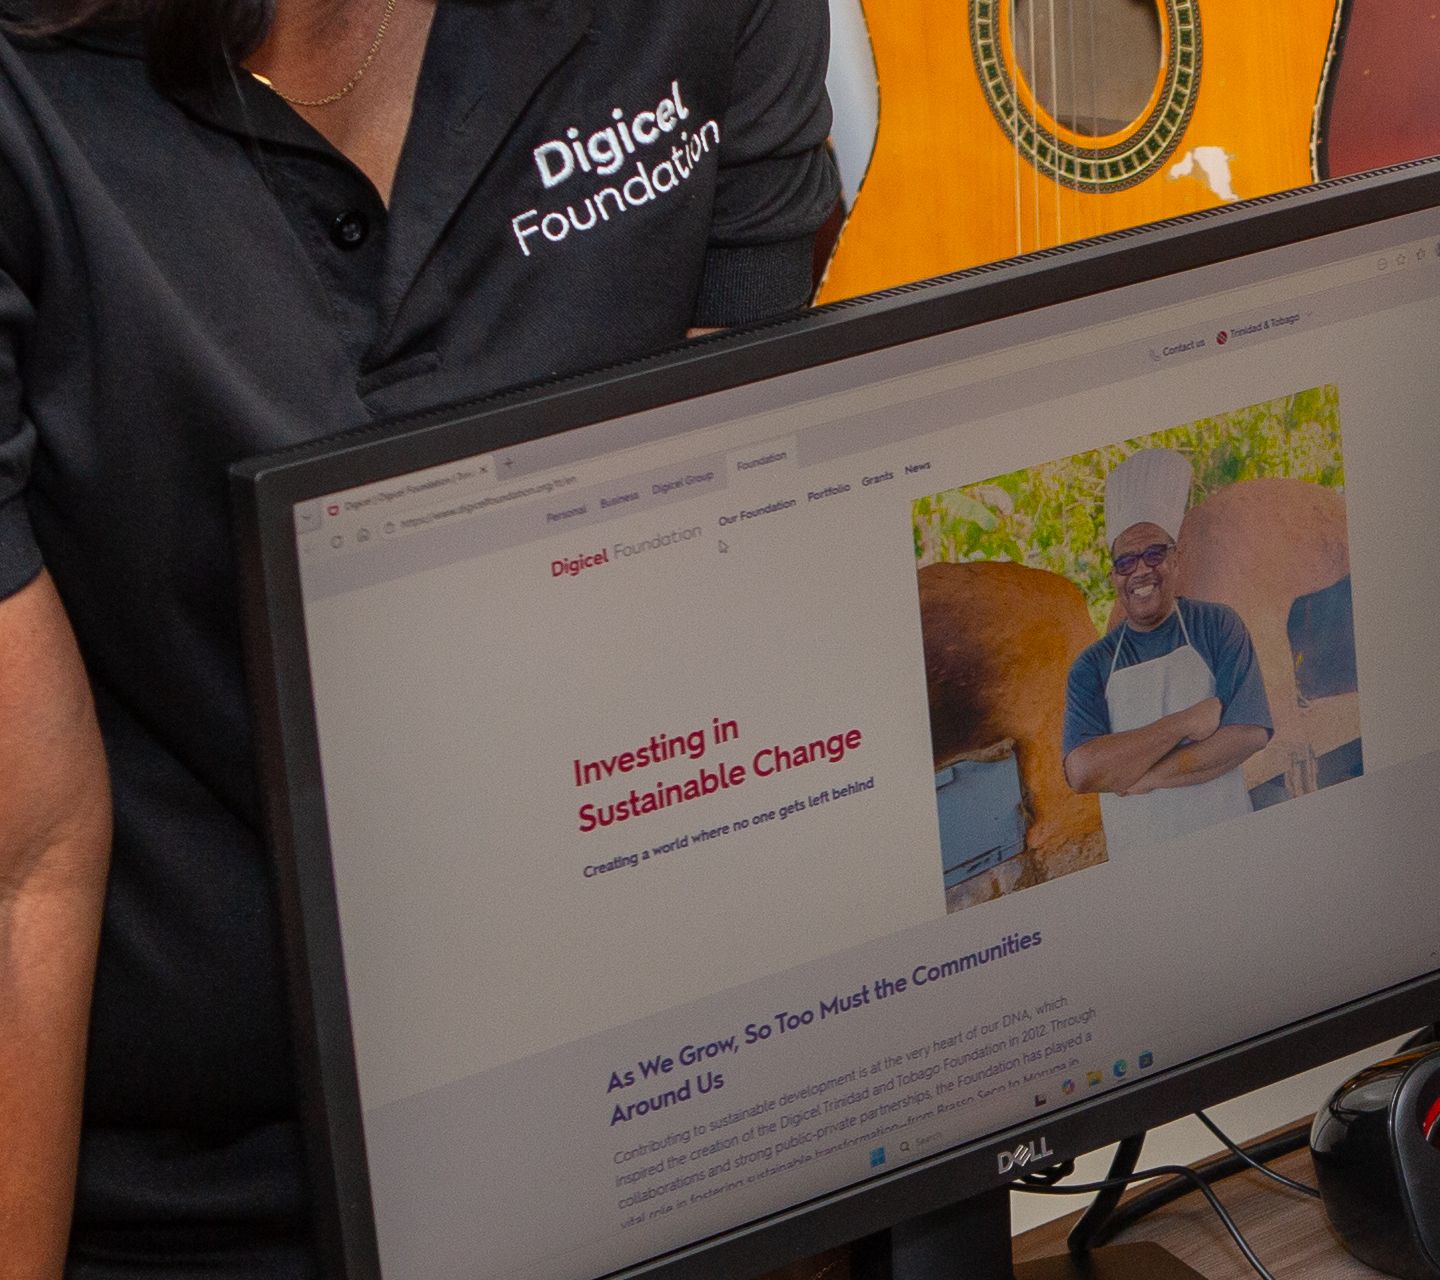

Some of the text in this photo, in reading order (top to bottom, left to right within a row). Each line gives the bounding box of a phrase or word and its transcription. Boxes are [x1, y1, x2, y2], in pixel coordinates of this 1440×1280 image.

[534, 80, 689, 189] Digicel
[512, 120, 720, 256] Foundation
[1162, 338, 1205, 356] Contact us
[651, 471, 714, 495] Digicel Group
[736, 452, 786, 472] Foundation
[861, 471, 894, 487] Grants
[904, 461, 930, 475] News
[546, 503, 586, 523] Personal
[599, 491, 639, 508] Business
[717, 498, 796, 527] Our Foundation
[807, 483, 851, 502] Portfolio
[550, 525, 702, 577] Digicel Foundation
[572, 716, 739, 787] Investing in
[576, 727, 862, 834] Sustainable Change
[582, 776, 874, 878] Creating a world where no one gets left behind
[604, 930, 1042, 1094] As We Grow, So Too Must the Communities
[607, 1071, 725, 1127] Around Us
[613, 994, 1068, 1165] Contributing to sustainable development is at the very heart of our DNA, which
[615, 1159, 664, 1187] inspired
[666, 1153, 687, 1169] the
[689, 1136, 738, 1161] creation
[741, 1127, 754, 1143] of
[756, 1121, 777, 1137] the
[779, 1103, 821, 1129] Digicel
[822, 1086, 869, 1114] Trinidad
[871, 1077, 894, 1096] and
[896, 1064, 940, 1088] Tobago
[942, 1040, 1006, 1071] Foundation
[1008, 1035, 1019, 1048] in
[1049, 1005, 1096, 1033] Through
[617, 1170, 706, 1209] collaborations
[707, 1158, 731, 1177] and
[734, 1146, 772, 1168] strong
[935, 1081, 954, 1096] the
[956, 1058, 1020, 1088] Foundation
[1022, 1050, 1042, 1065] has
[1044, 1032, 1082, 1060] played
[1084, 1032, 1092, 1043] a
[997, 1136, 1054, 1174] DELL
